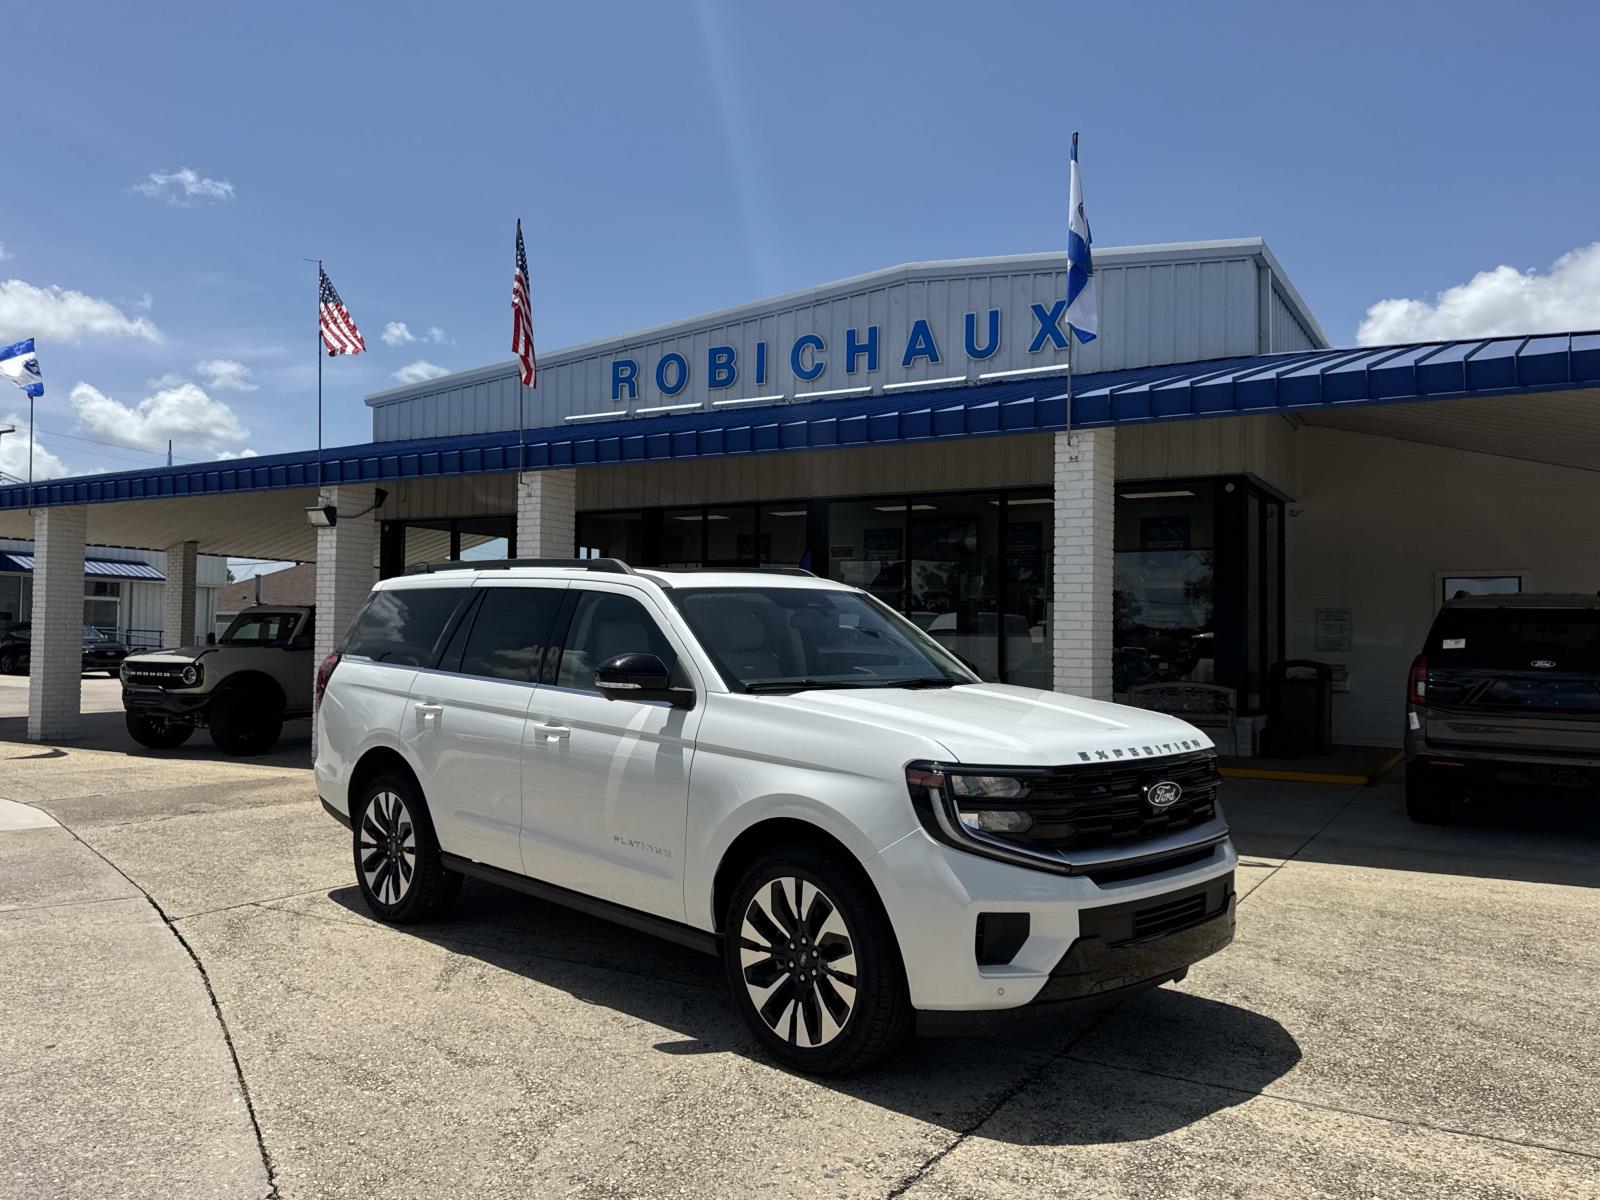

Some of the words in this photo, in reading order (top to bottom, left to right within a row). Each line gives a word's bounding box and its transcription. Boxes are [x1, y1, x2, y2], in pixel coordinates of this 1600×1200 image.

[610, 299, 1070, 402] ROBICHAUX
[1077, 738, 1201, 762] EXPEDITION
[1153, 785, 1177, 804] Ford
[612, 835, 671, 858] PLATINUM
